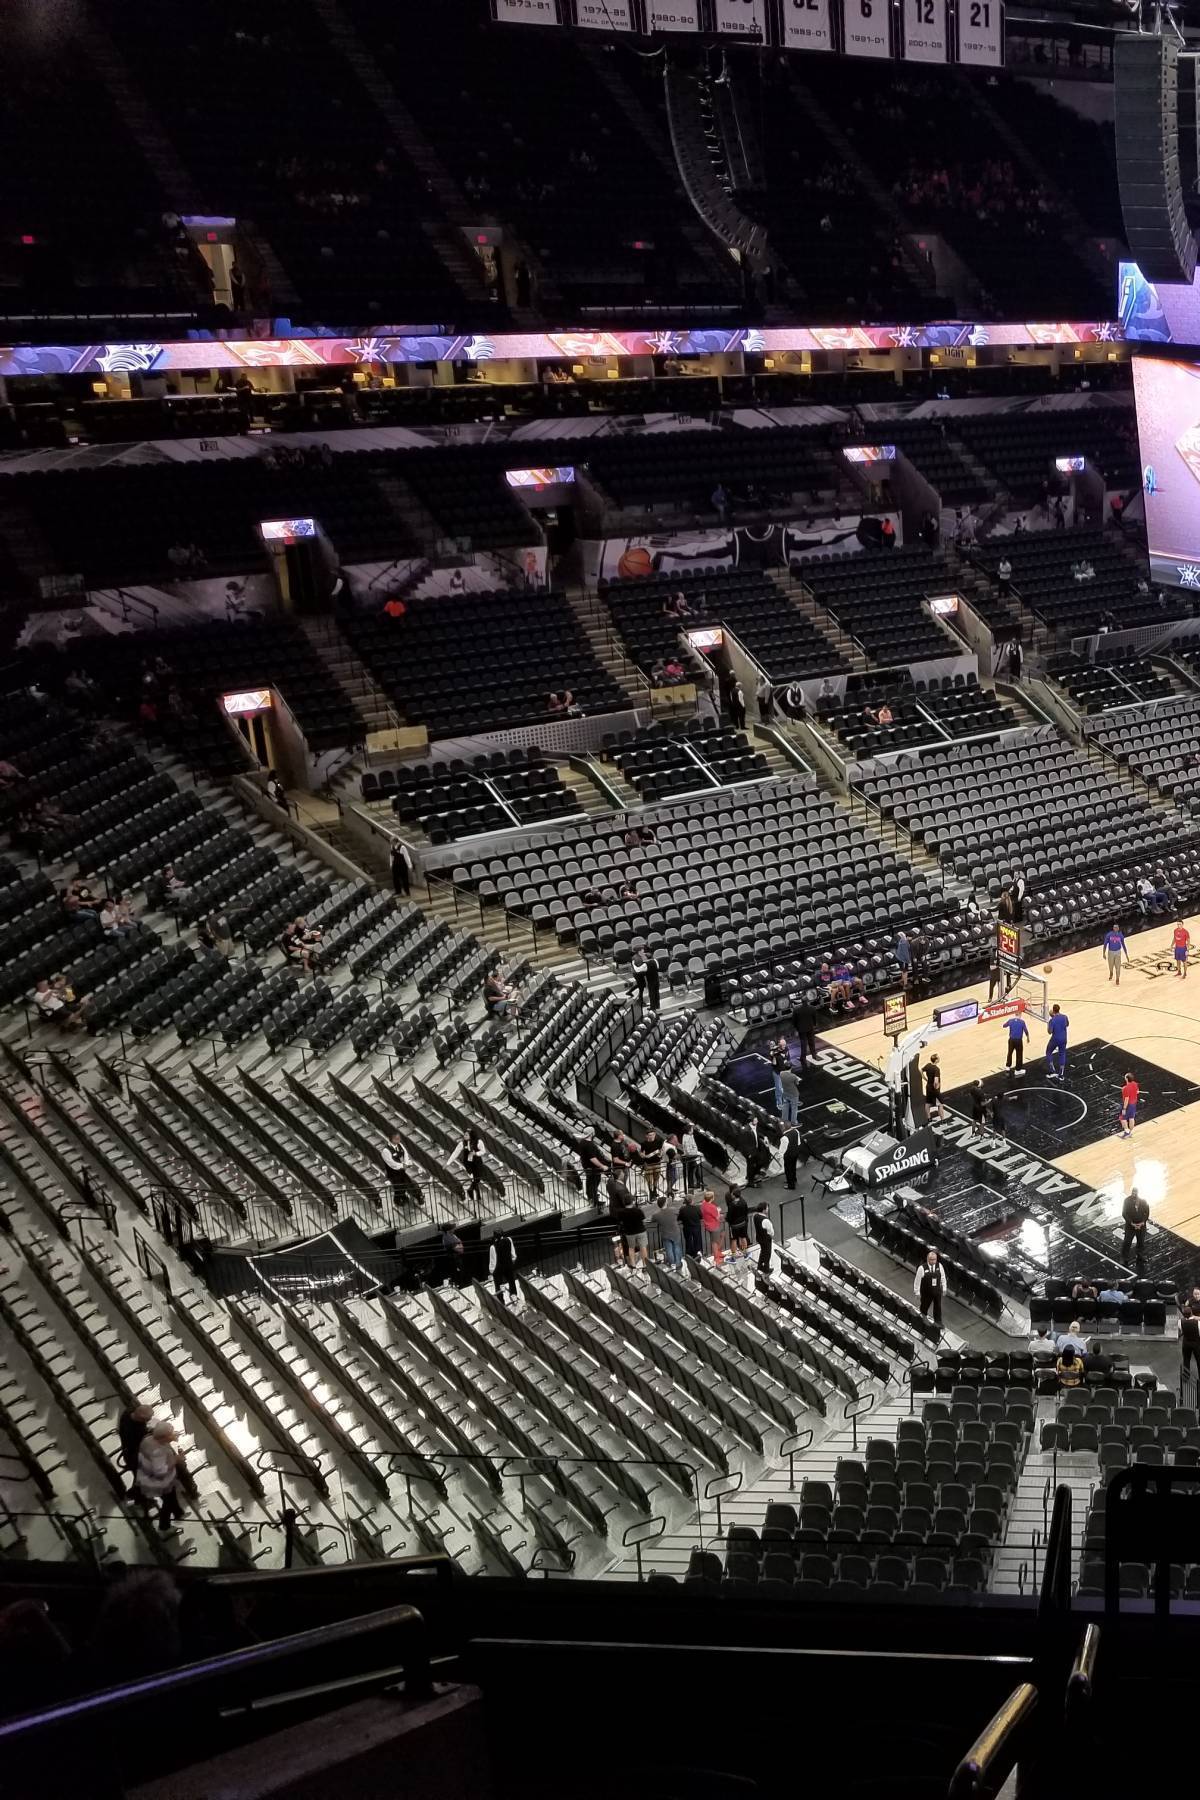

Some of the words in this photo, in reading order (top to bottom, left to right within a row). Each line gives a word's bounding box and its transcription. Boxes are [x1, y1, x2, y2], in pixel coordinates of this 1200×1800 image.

[915, 0, 935, 24] 12
[969, 3, 991, 28] 21
[1001, 934, 1015, 953] 24
[874, 1148, 930, 1183] SPALDING
